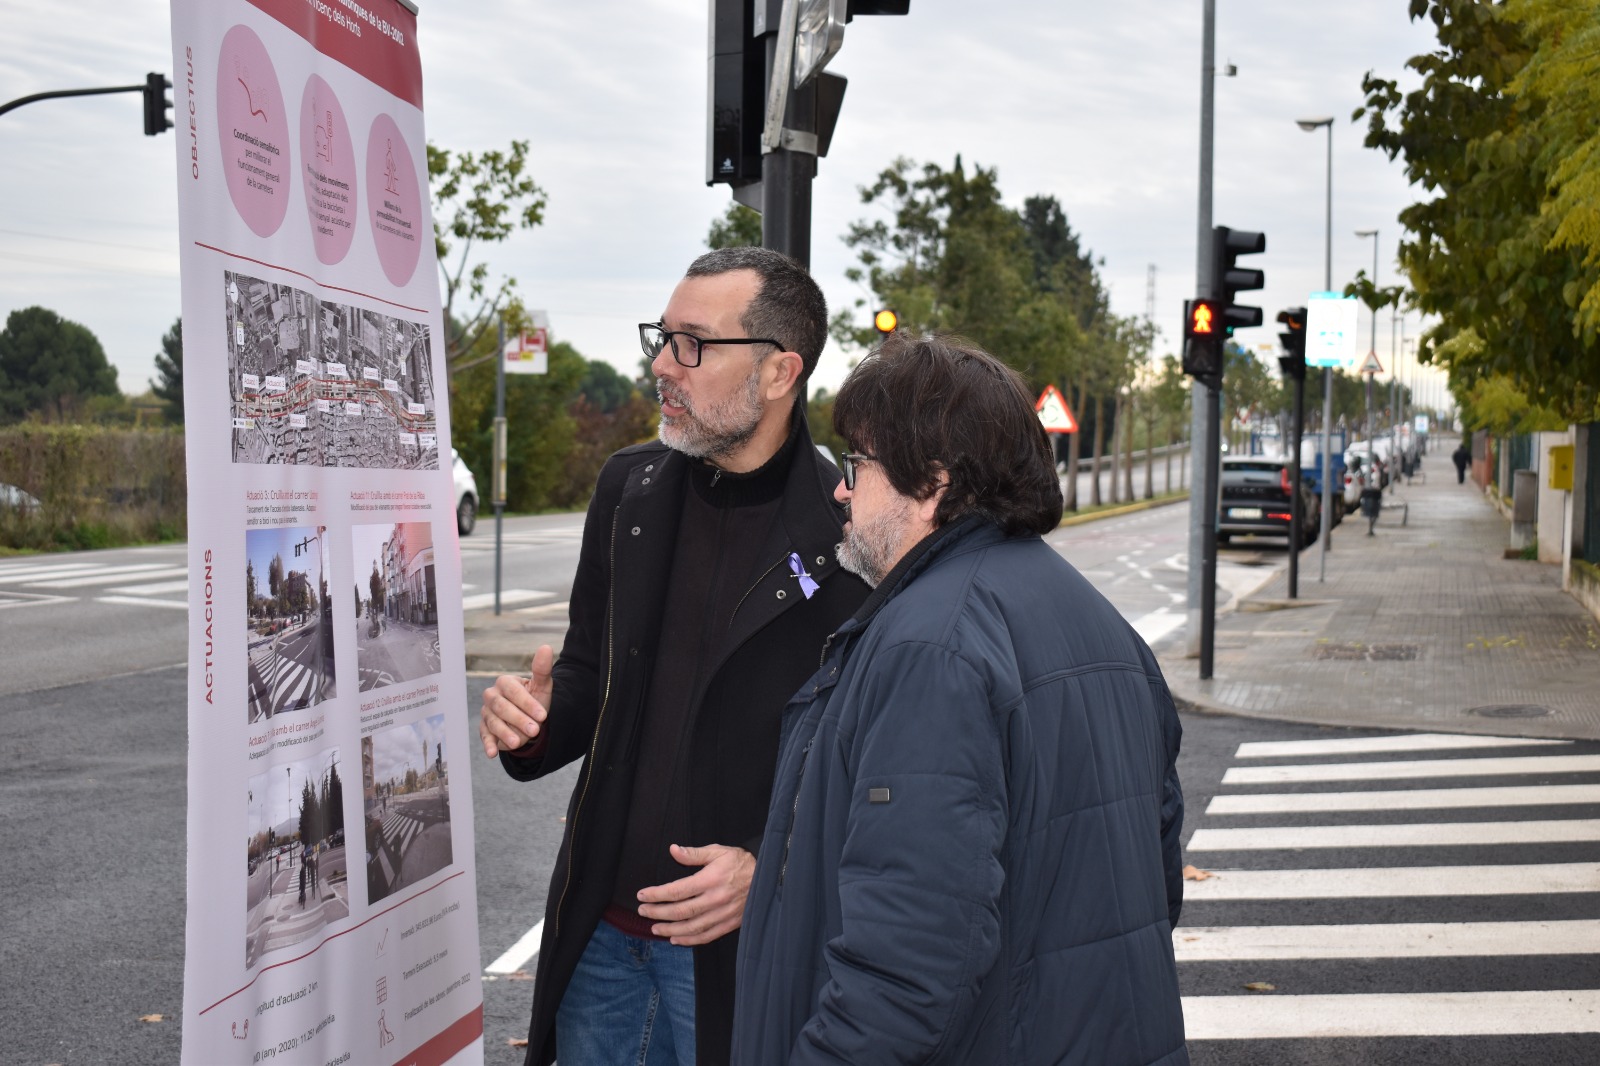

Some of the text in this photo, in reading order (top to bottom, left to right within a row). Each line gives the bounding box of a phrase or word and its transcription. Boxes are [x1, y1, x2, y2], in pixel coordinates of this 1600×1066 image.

[333, 8, 346, 26] dels
[346, 15, 361, 37] Horts
[369, 10, 376, 26] de
[376, 16, 382, 31] la
[186, 46, 198, 180] OBJECTIUS
[234, 128, 260, 146] Coordinació
[294, 491, 309, 500] carrer
[204, 549, 213, 704] ACTUACIONS
[276, 725, 288, 736] amb
[288, 723, 294, 732] el
[276, 738, 302, 748] modificació
[262, 1047, 277, 1061] (any
